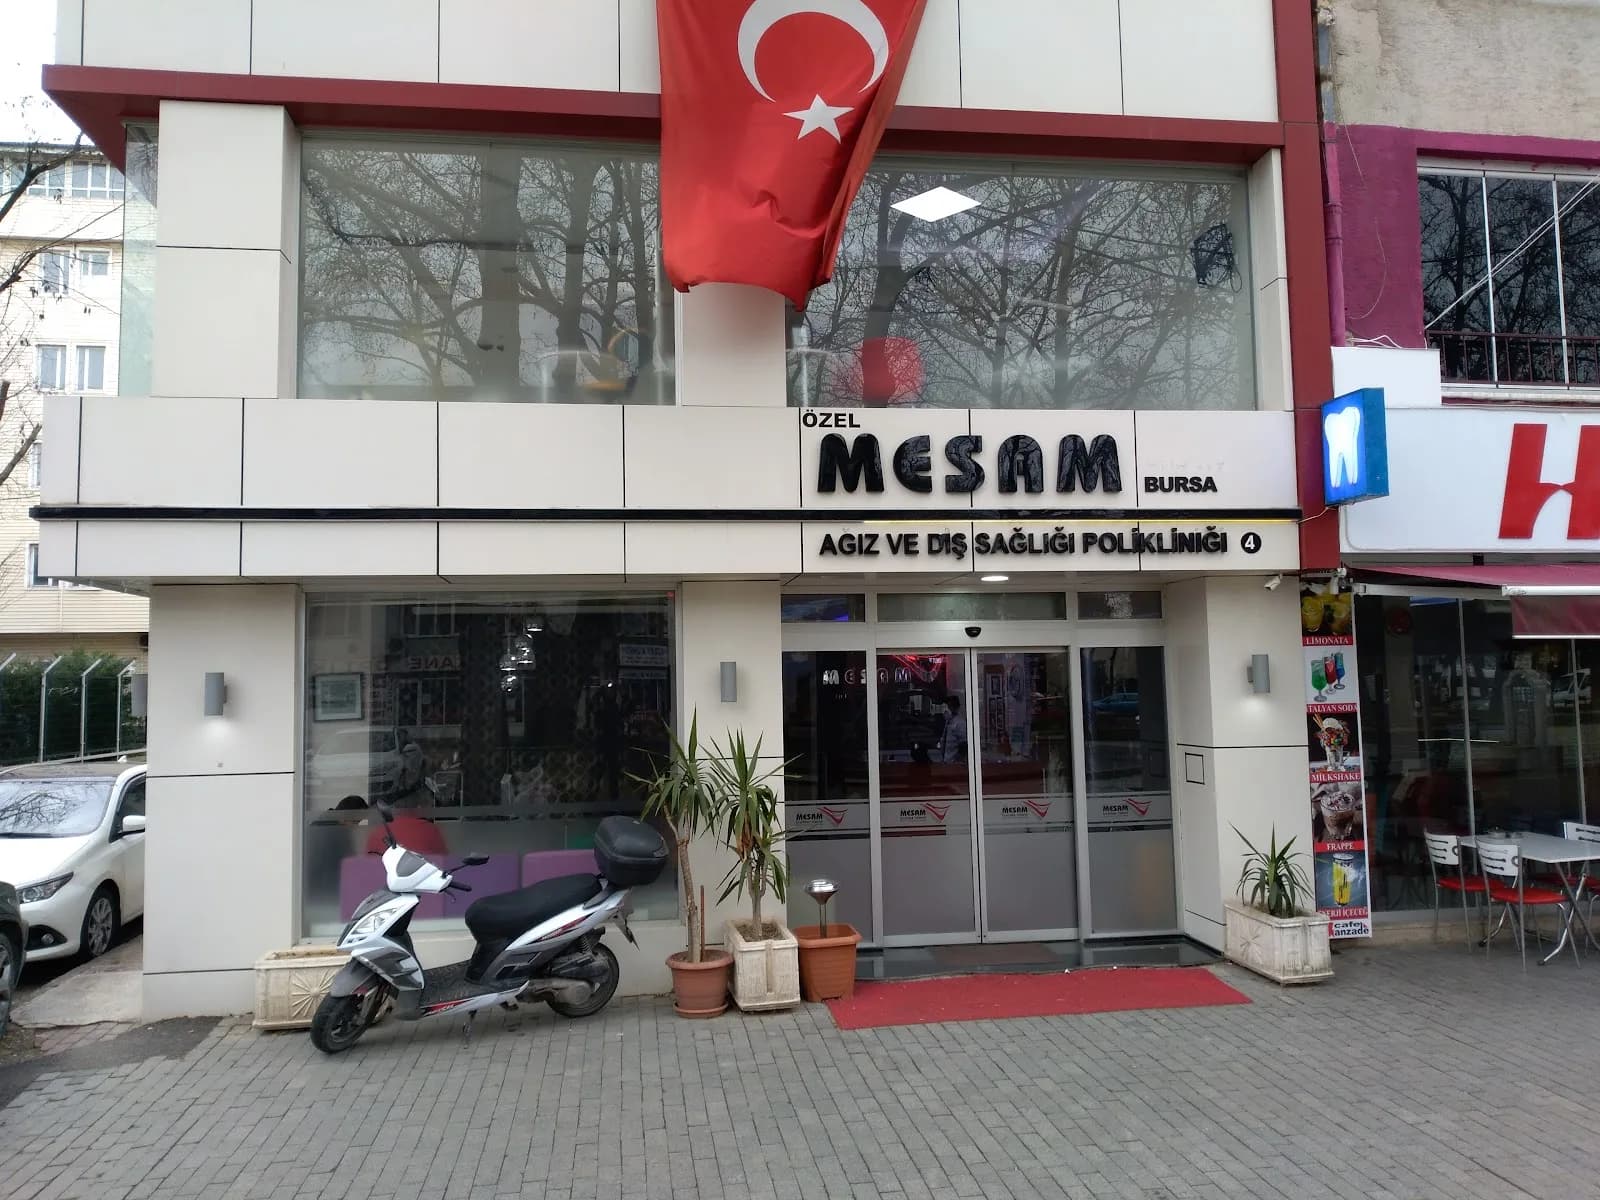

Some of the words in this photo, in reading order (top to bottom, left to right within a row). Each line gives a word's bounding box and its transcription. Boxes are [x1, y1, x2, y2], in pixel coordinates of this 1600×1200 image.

[802, 410, 860, 428] ÖZEL
[817, 433, 1122, 493] MESAM
[1144, 476, 1217, 493] BURSA
[886, 533, 919, 555] VE
[975, 526, 1075, 555] SAĞLIĞI
